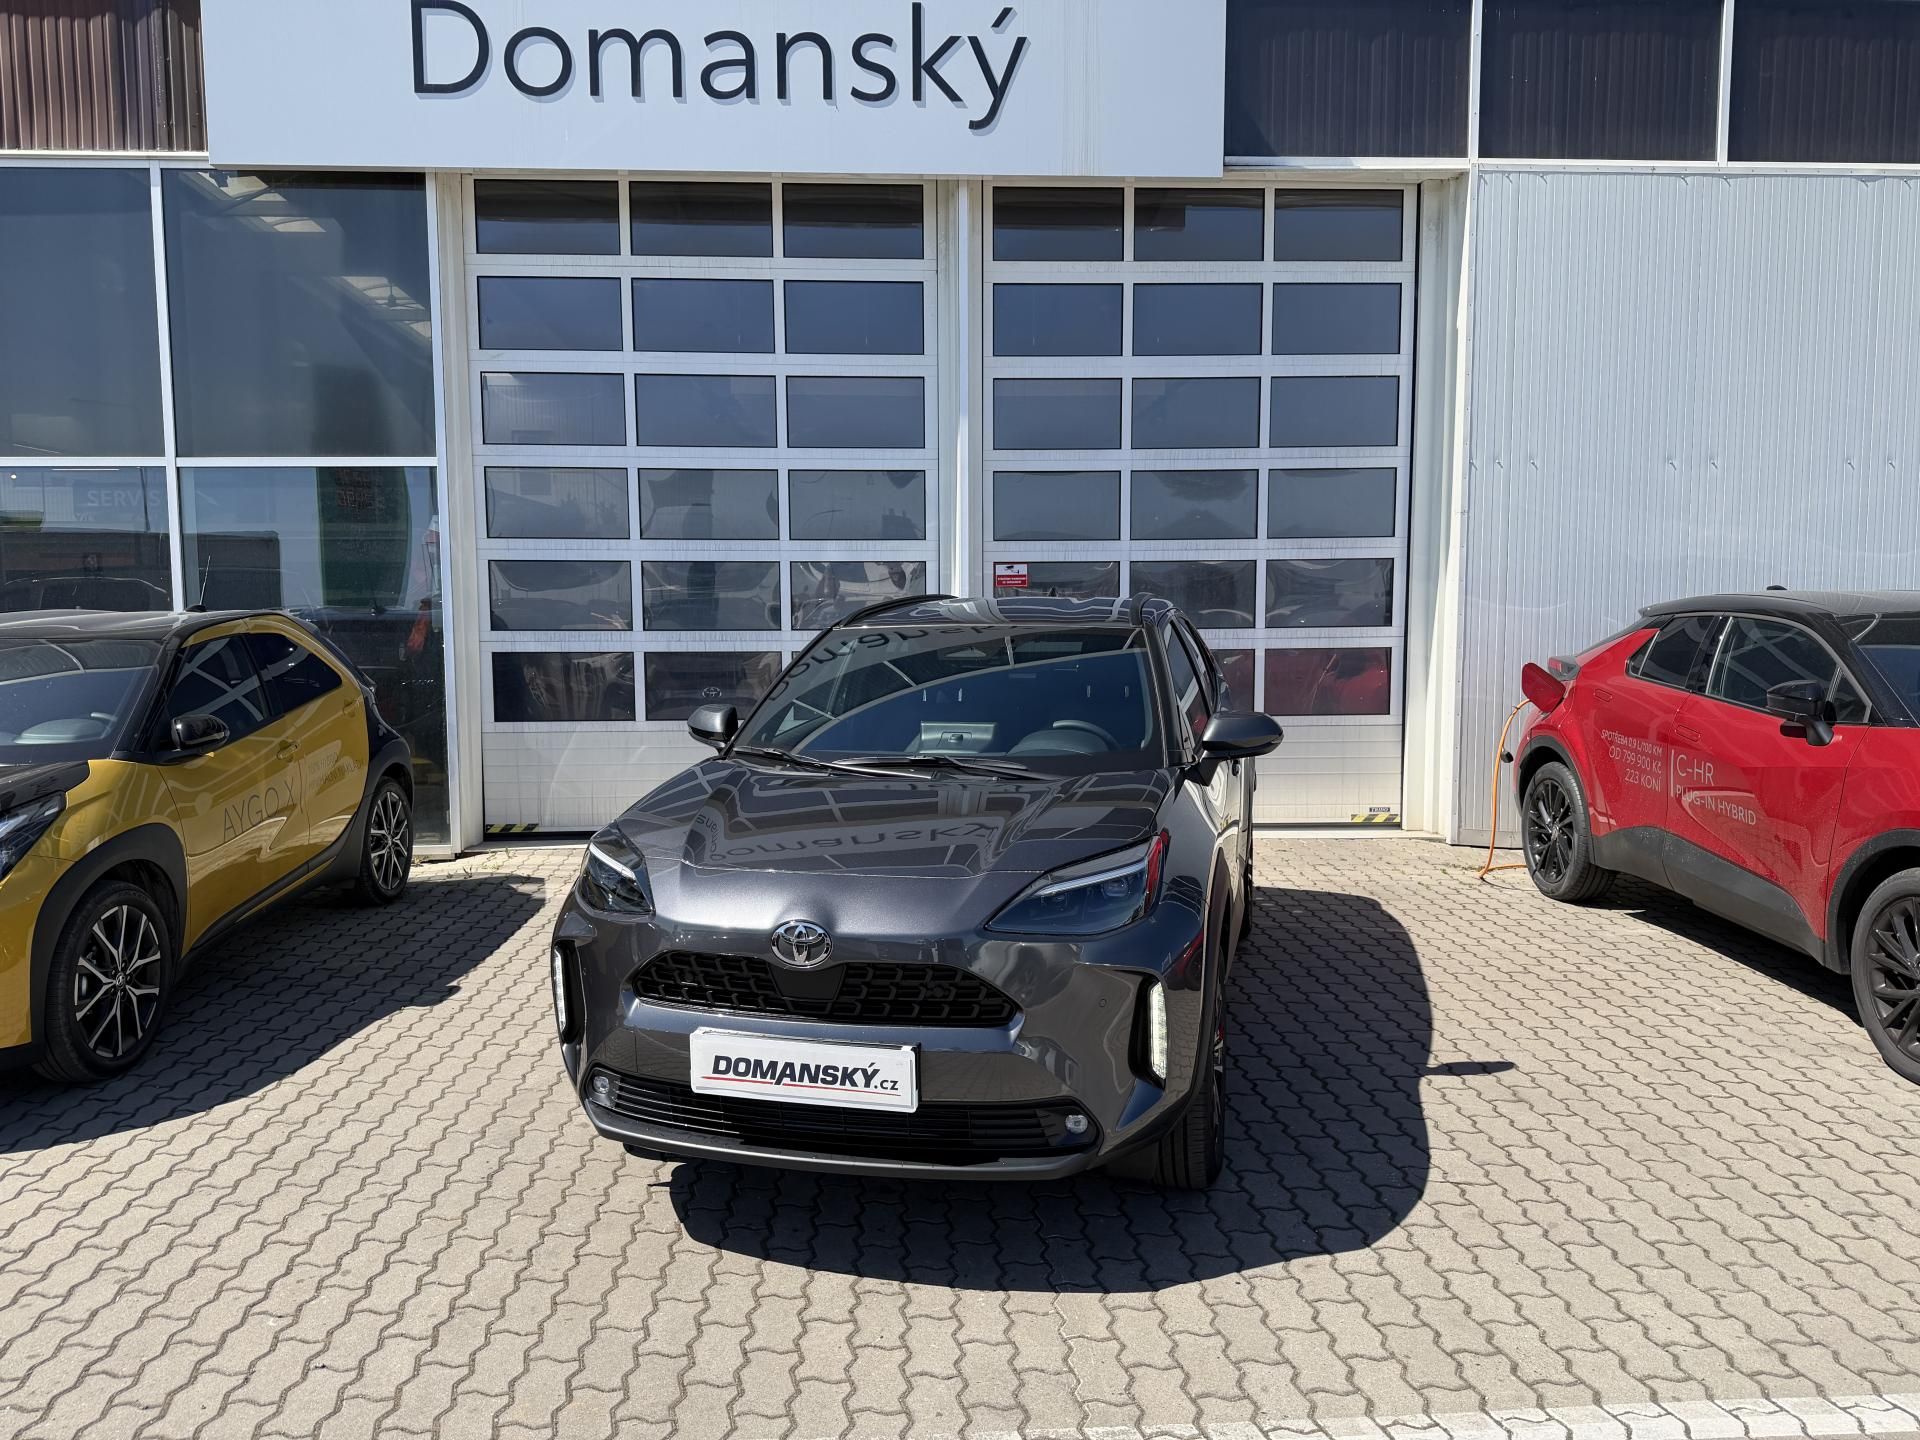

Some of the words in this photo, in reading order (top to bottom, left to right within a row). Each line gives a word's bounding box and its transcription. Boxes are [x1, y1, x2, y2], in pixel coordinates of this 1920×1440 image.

[411, 0, 1027, 130] Domanský
[1608, 745, 1622, 760] OD
[1622, 749, 1636, 765] 799
[1636, 754, 1651, 770] 900
[1676, 754, 1714, 787] C-HR
[1624, 768, 1639, 784] 223
[1640, 775, 1661, 793] KONÍ
[223, 787, 279, 842] AYGO
[284, 777, 296, 807] X
[1676, 785, 1715, 811] PLUG-IN
[1718, 799, 1757, 826] HYBRID
